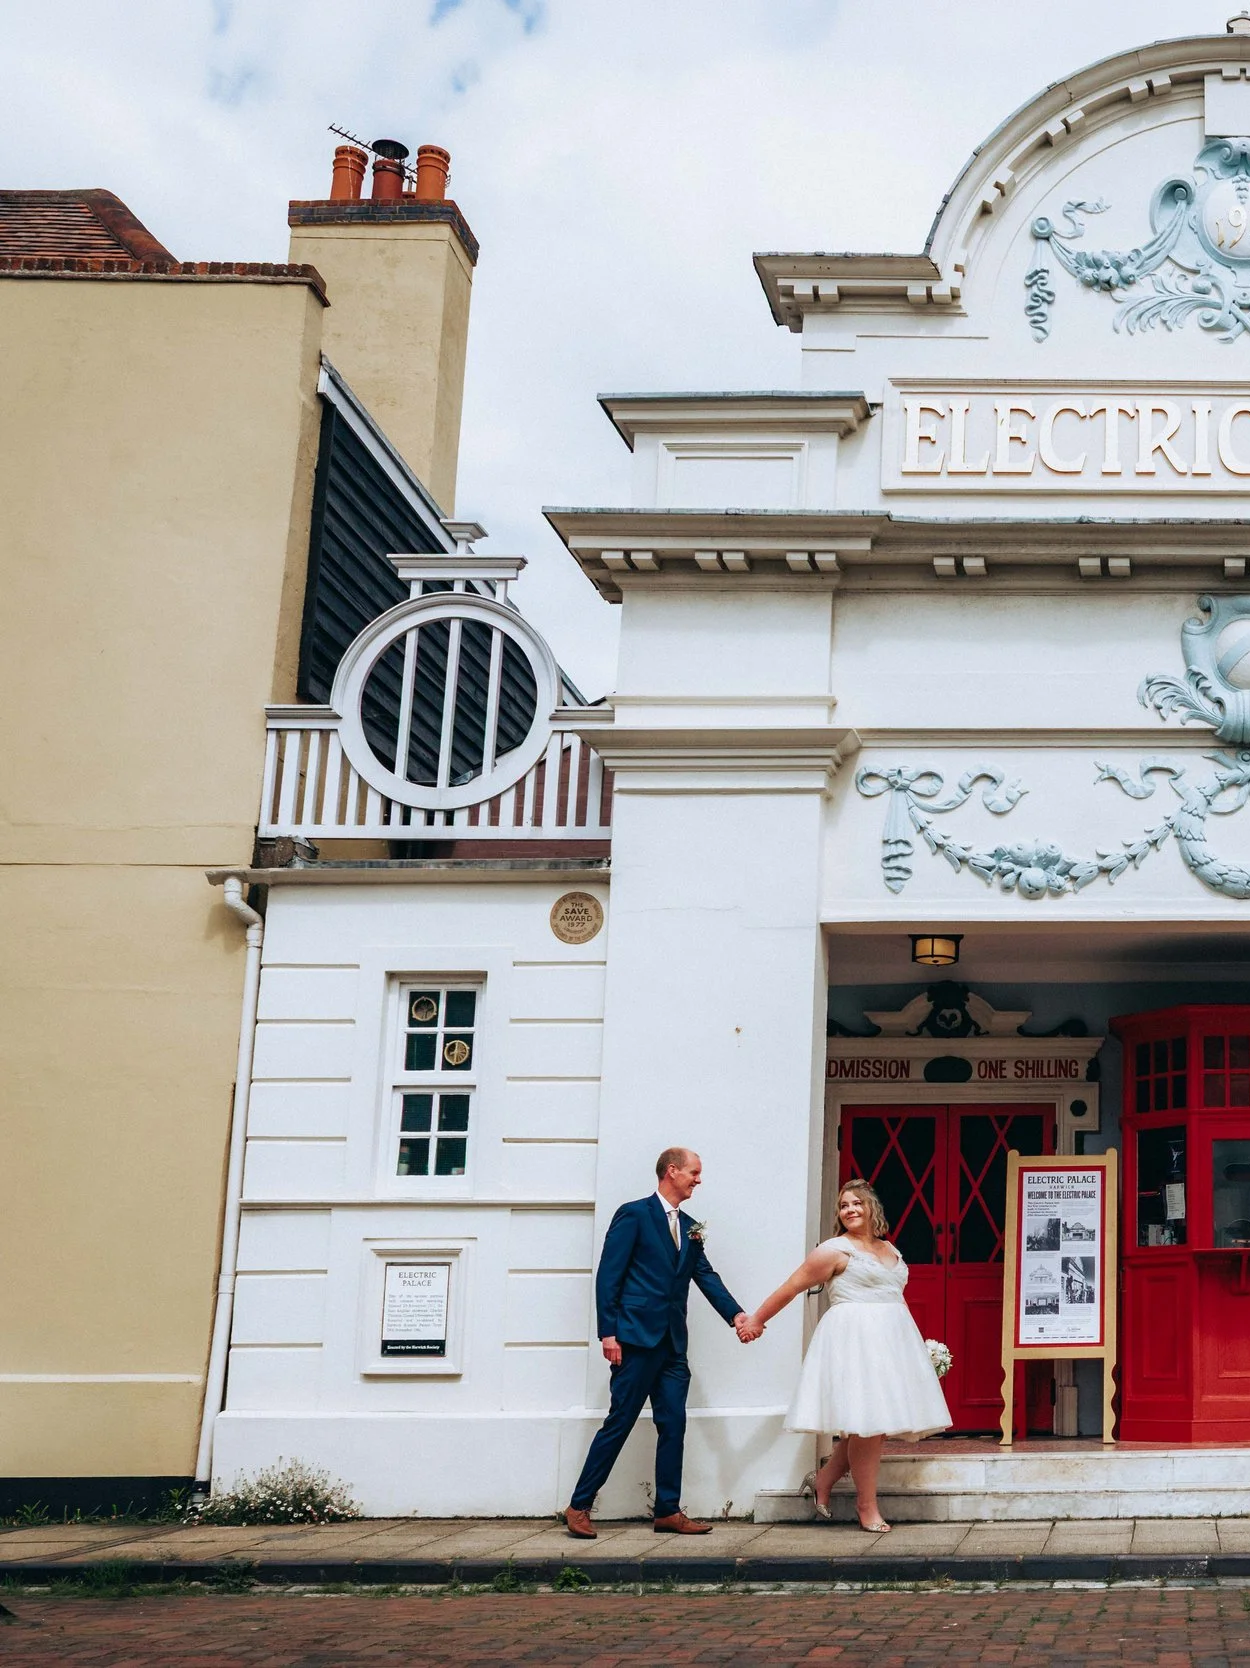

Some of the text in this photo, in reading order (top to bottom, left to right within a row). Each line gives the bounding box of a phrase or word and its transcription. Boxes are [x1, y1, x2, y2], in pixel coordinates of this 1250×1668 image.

[825, 1059, 1079, 1079] DMISSION ONE SHILLING
[1027, 1175, 1096, 1184] ELECTRIC PALACE
[1027, 1191, 1047, 1199] WELCOME
[1048, 1191, 1053, 1199] TO
[1062, 1190, 1081, 1199] ELECTRIC
[1081, 1190, 1096, 1199] PALACE
